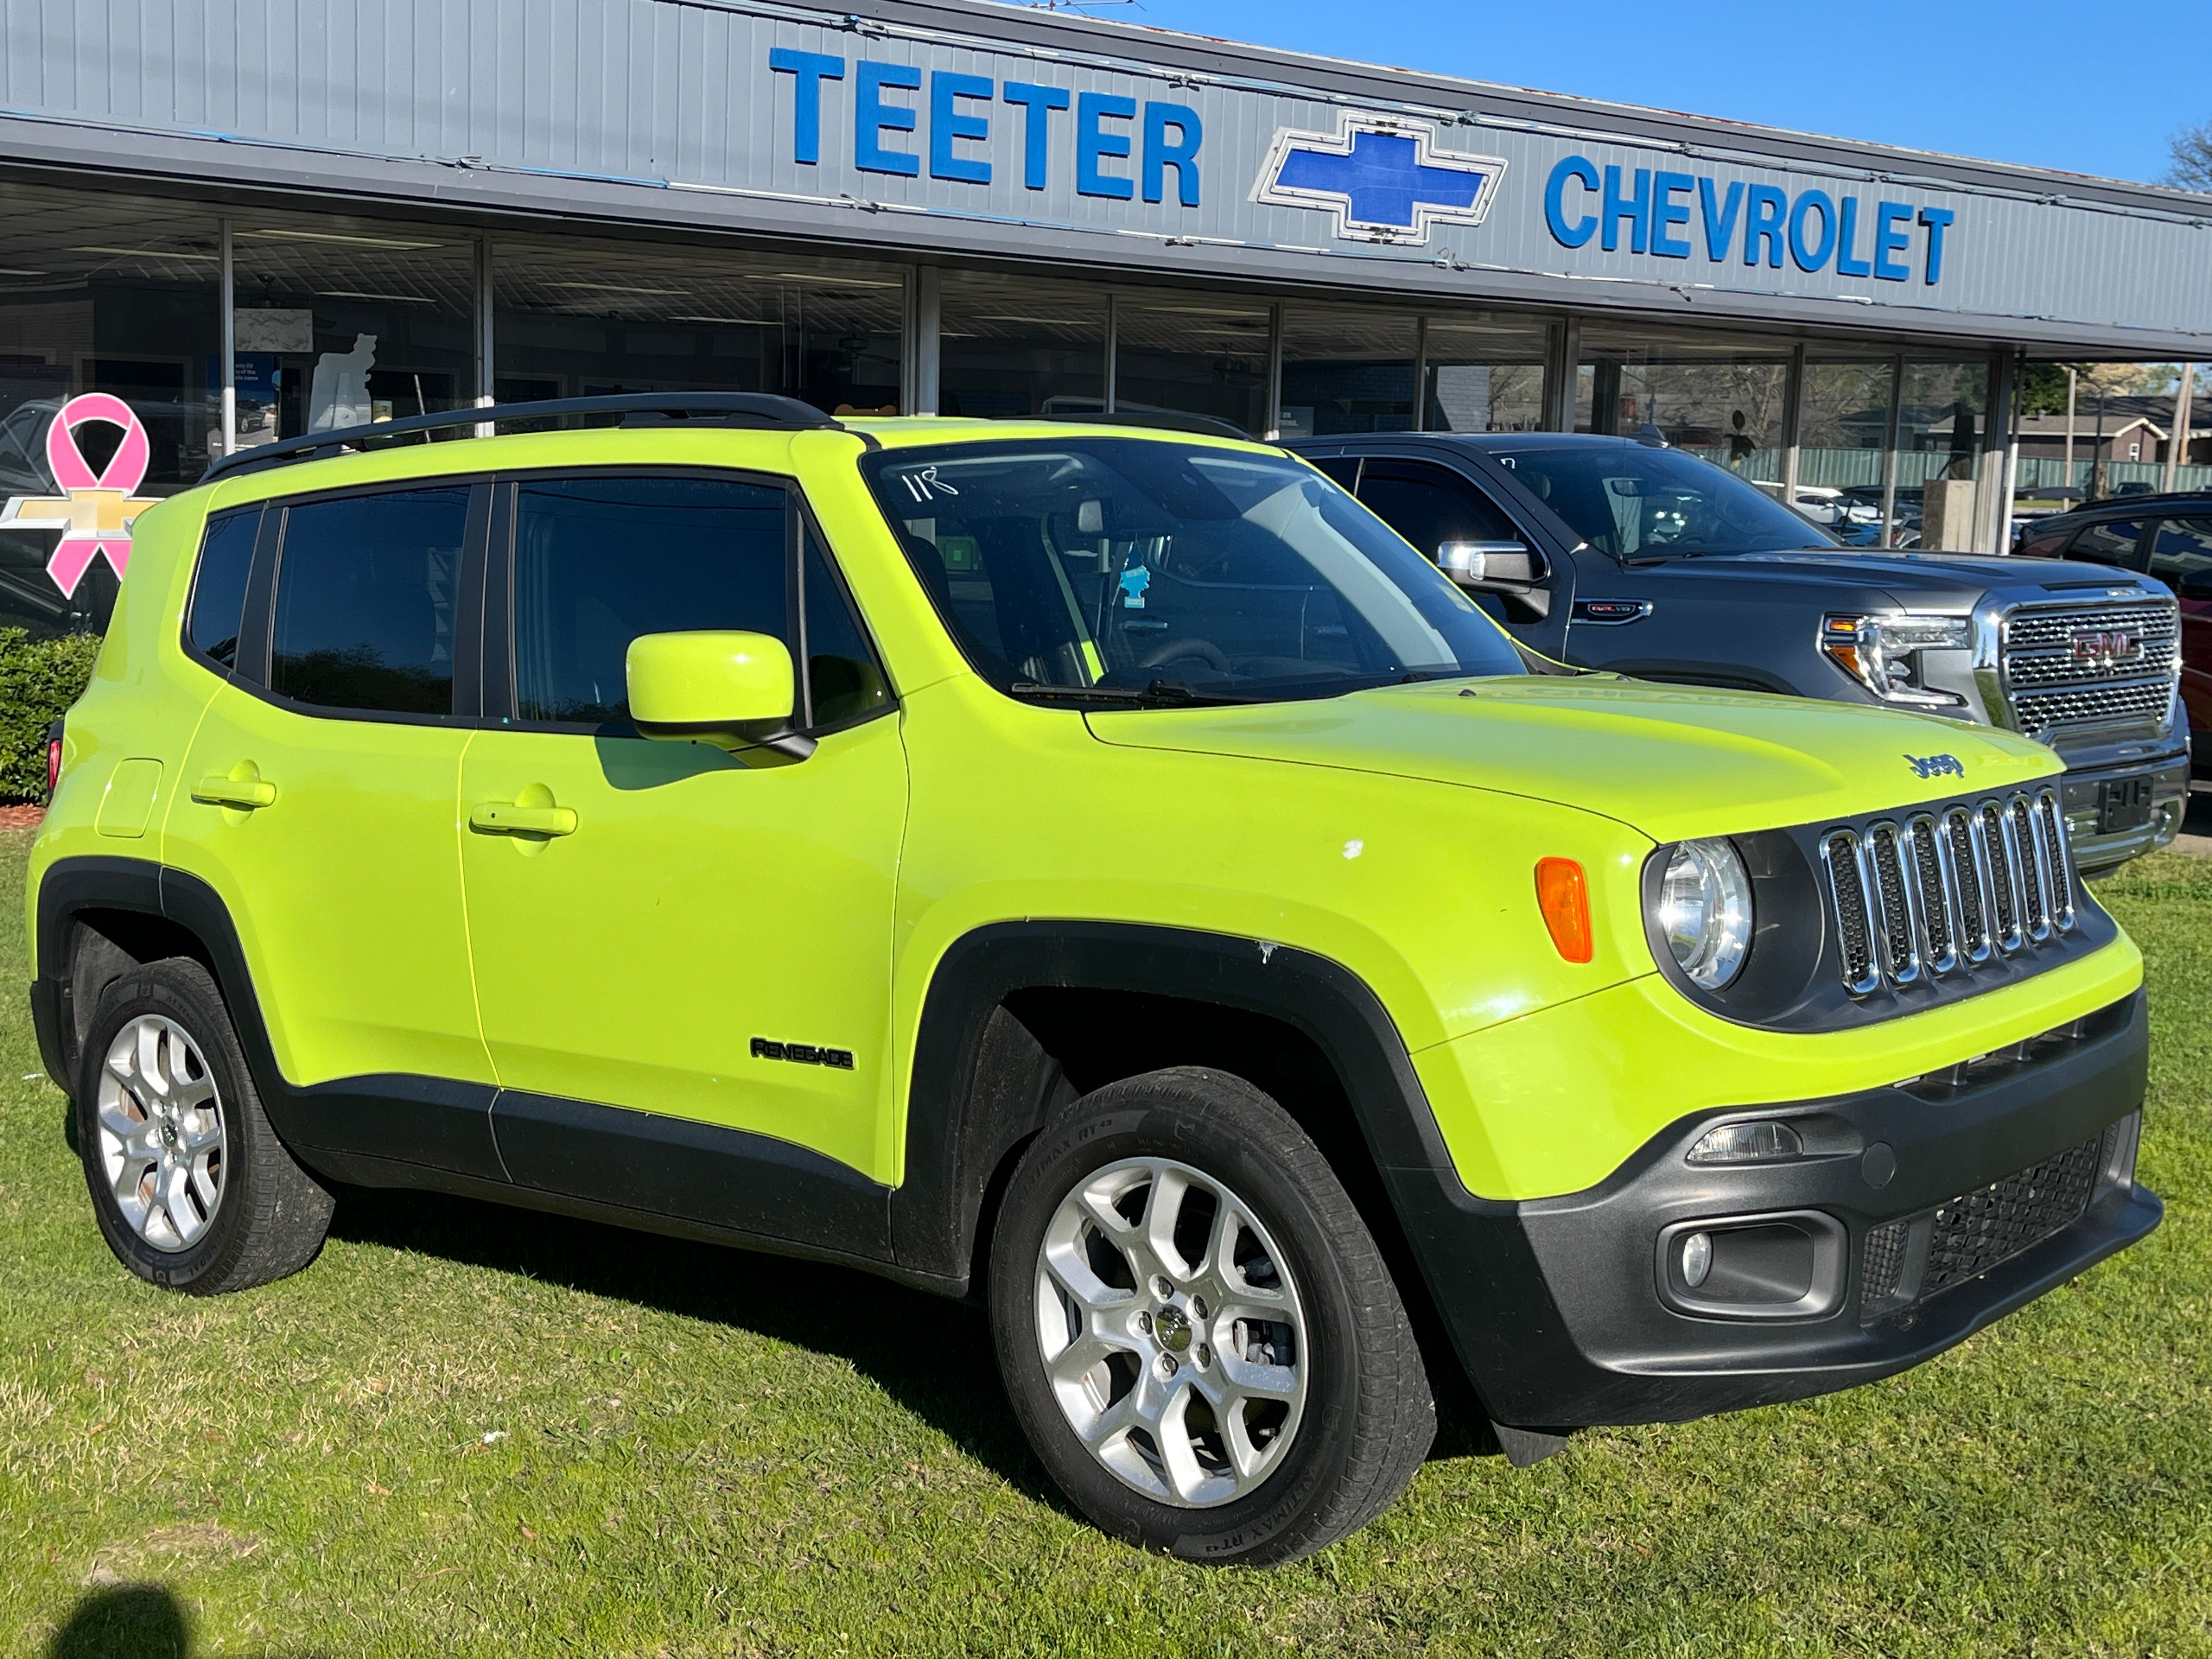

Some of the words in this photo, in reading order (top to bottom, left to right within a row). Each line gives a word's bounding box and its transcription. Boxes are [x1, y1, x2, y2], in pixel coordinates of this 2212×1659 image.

[769, 47, 1203, 207] TEETER
[1544, 155, 1955, 285] CHEVROLET
[2075, 631, 2141, 660] GMC
[1902, 754, 1965, 780] Jeep
[749, 1036, 855, 1071] RENEGADE
